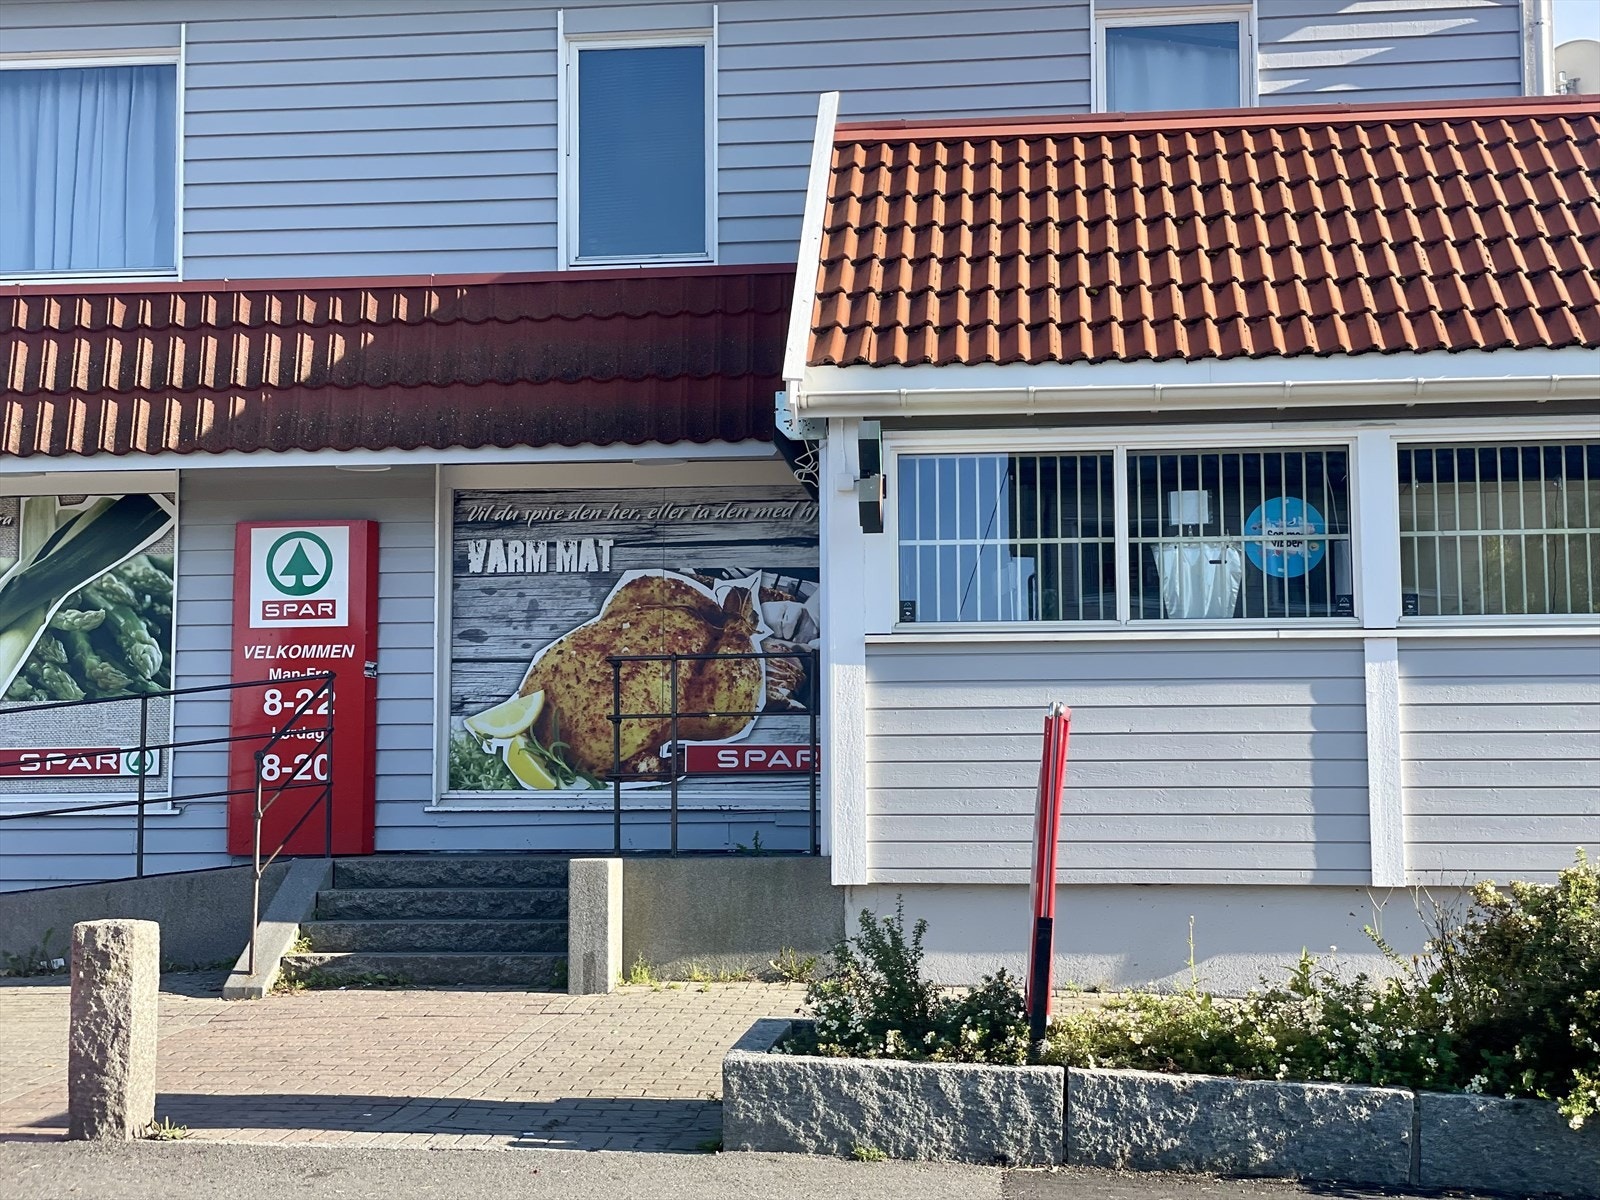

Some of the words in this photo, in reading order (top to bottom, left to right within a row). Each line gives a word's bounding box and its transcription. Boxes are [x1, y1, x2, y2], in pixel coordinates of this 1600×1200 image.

[467, 504, 495, 522] Vil
[494, 504, 519, 521] du
[523, 505, 565, 528] spise
[568, 503, 601, 520] den
[607, 503, 641, 520] her,
[647, 502, 688, 519] eller
[691, 504, 711, 519] ta
[715, 502, 749, 519] den
[754, 501, 799, 519] med
[467, 538, 548, 574] VARM
[555, 537, 615, 573] MAT
[265, 602, 333, 617] SPAR
[244, 644, 355, 659] VELKOMMEN
[263, 688, 336, 716] 8-22
[20, 752, 118, 772] SPAR
[261, 753, 329, 781] 8-20
[717, 749, 818, 769] SPAR
